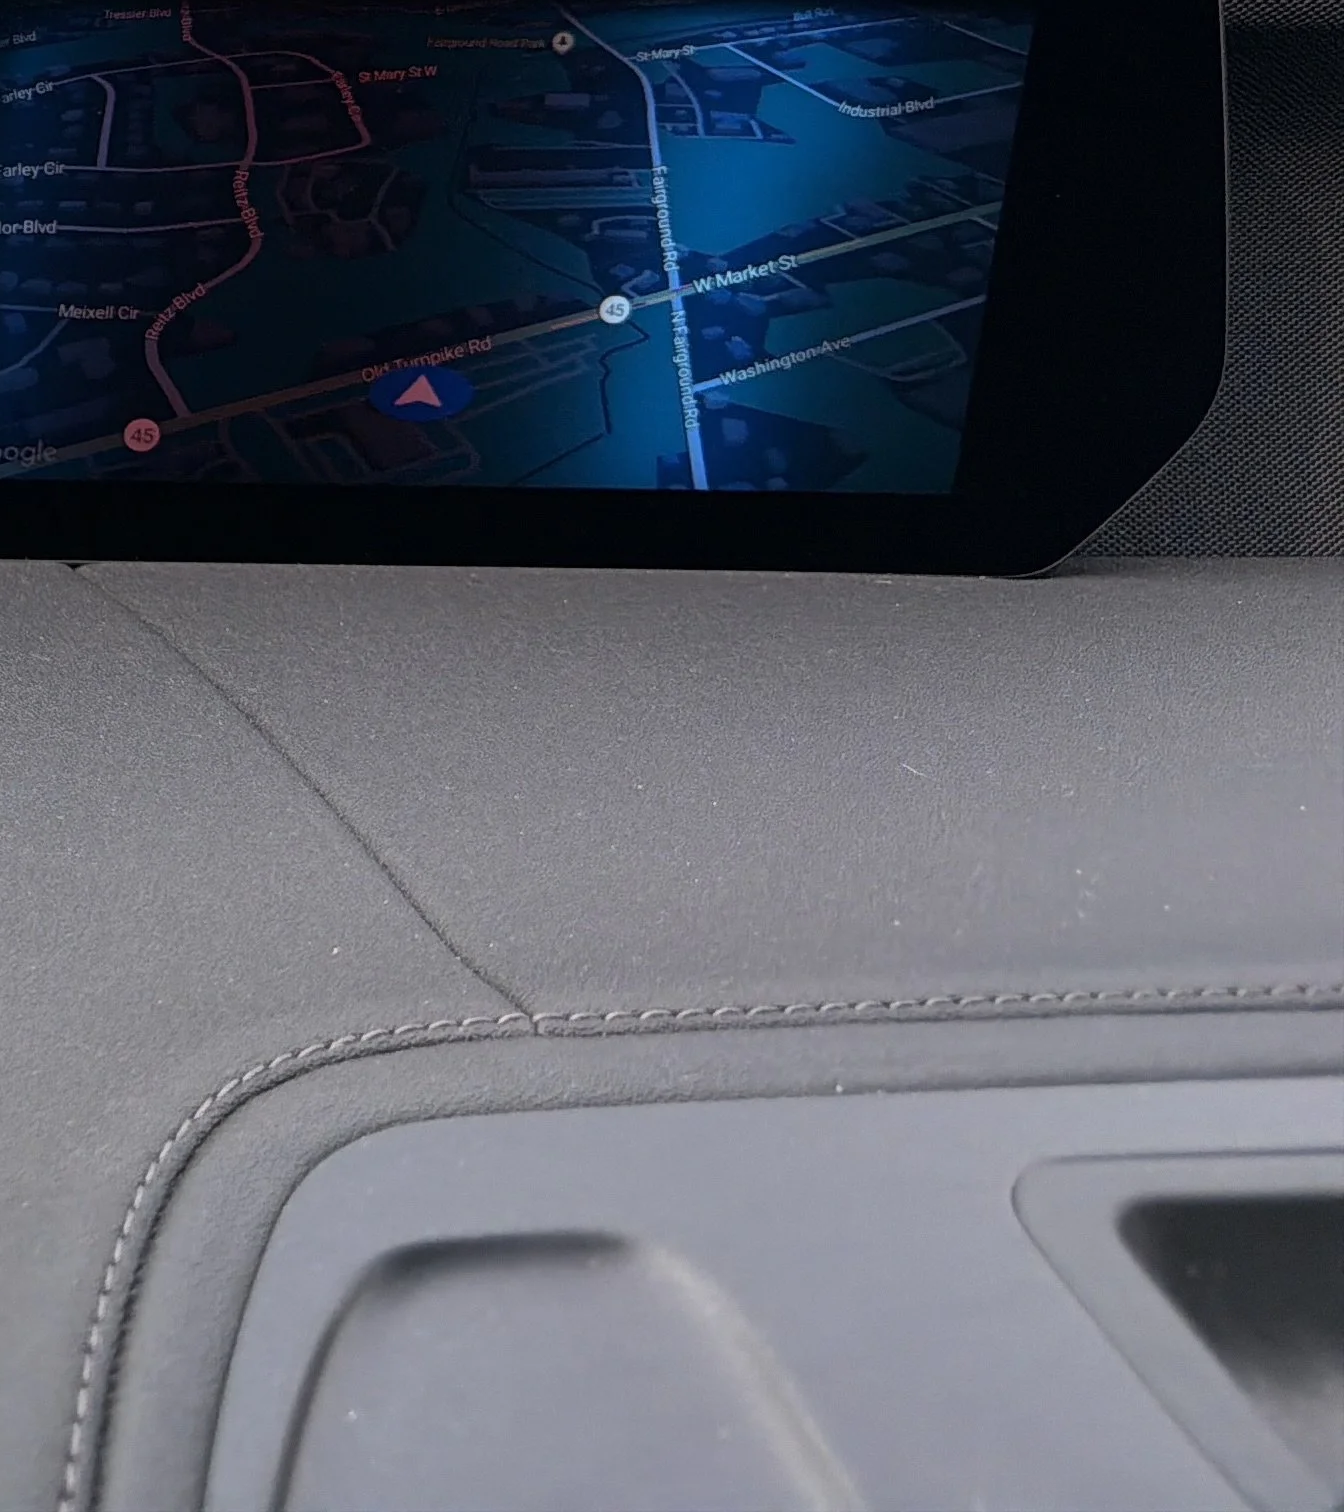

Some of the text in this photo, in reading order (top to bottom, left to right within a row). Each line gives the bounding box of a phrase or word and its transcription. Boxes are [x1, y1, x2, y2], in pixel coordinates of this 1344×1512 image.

[651, 47, 680, 62] Mary
[423, 64, 439, 77] W
[35, 81, 55, 95] Cir
[838, 96, 936, 118] Industrial Blvd
[45, 160, 66, 176] Cir
[232, 170, 265, 239] Reitz Blvd
[22, 219, 58, 236] Blvd
[652, 166, 680, 272] Fairground Rd
[692, 254, 800, 295] W Market St
[58, 304, 141, 321] Meixell Cir
[145, 283, 207, 340] Reitz Blvd
[604, 302, 626, 318] 45
[392, 345, 464, 368] Turnpike
[468, 335, 493, 355] Rd
[719, 335, 852, 386] Washington Ave
[672, 322, 698, 408] Fairground
[684, 406, 700, 430] Rd
[129, 427, 156, 445] 45
